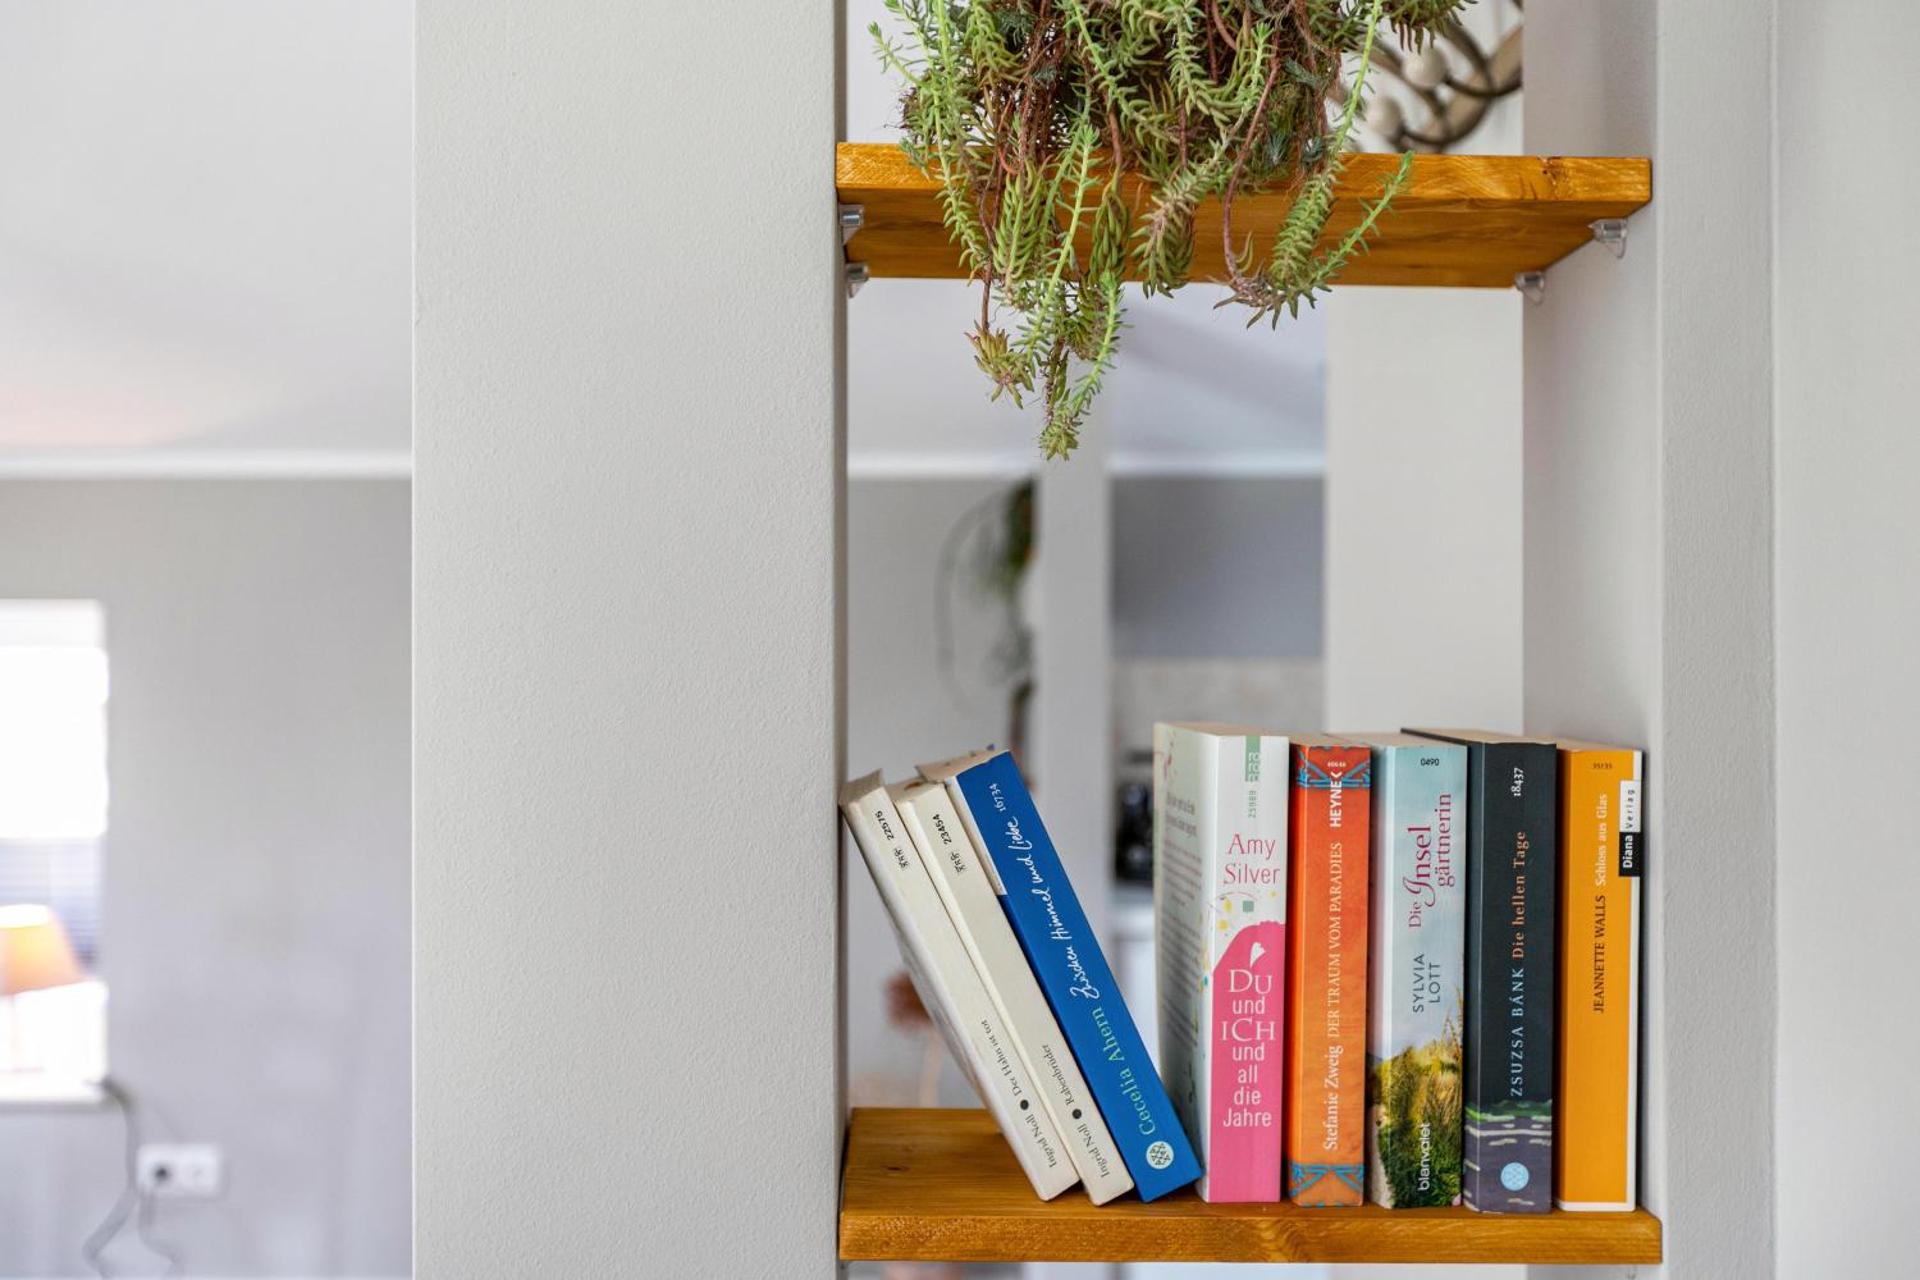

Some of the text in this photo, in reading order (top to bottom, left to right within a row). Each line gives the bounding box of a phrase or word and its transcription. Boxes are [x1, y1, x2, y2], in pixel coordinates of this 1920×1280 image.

[1420, 758, 1440, 767] 0490
[1510, 767, 1525, 797] 18437
[989, 782, 1006, 812] 16734
[1329, 780, 1343, 828] HEYNE
[932, 813, 952, 844] 23454
[1227, 833, 1276, 861] Amy
[1434, 794, 1456, 888] gärtnerin
[1595, 793, 1608, 887] Schloss aus Glas
[1622, 789, 1635, 869] Diana Verlag
[1223, 862, 1280, 885] Silver
[1005, 816, 1100, 1000] Zwischen Himmel und Liebe
[1408, 902, 1422, 928] Die
[1511, 831, 1530, 959] Die hellen Tage
[1327, 841, 1343, 1039] DER TRAUM VOM PARADIES
[1592, 895, 1606, 1013] JEANNETTE WALLS
[1412, 953, 1426, 1013] SYLVIA
[1428, 962, 1441, 1004] LOTT
[1232, 996, 1265, 1015] und
[980, 1019, 993, 1035] tot
[1220, 1018, 1276, 1042] ICH
[1509, 967, 1525, 1097] ZSUZSA BÁNK
[996, 1047, 1012, 1076] Hahn
[1091, 1006, 1156, 1136] Cecelia Ahern
[1232, 1043, 1265, 1061] und
[1009, 1076, 1022, 1096] Der
[1042, 1043, 1075, 1106] Rabenbrüder
[1237, 1064, 1258, 1084] all
[1233, 1086, 1261, 1105] die
[1322, 1045, 1344, 1151] Stefanie Zweig
[1223, 1108, 1272, 1128] Jahre
[1025, 1114, 1058, 1168] Ingrid Noll
[1077, 1123, 1110, 1178] Ingrid Noll
[1417, 1122, 1431, 1191] blanvalet
